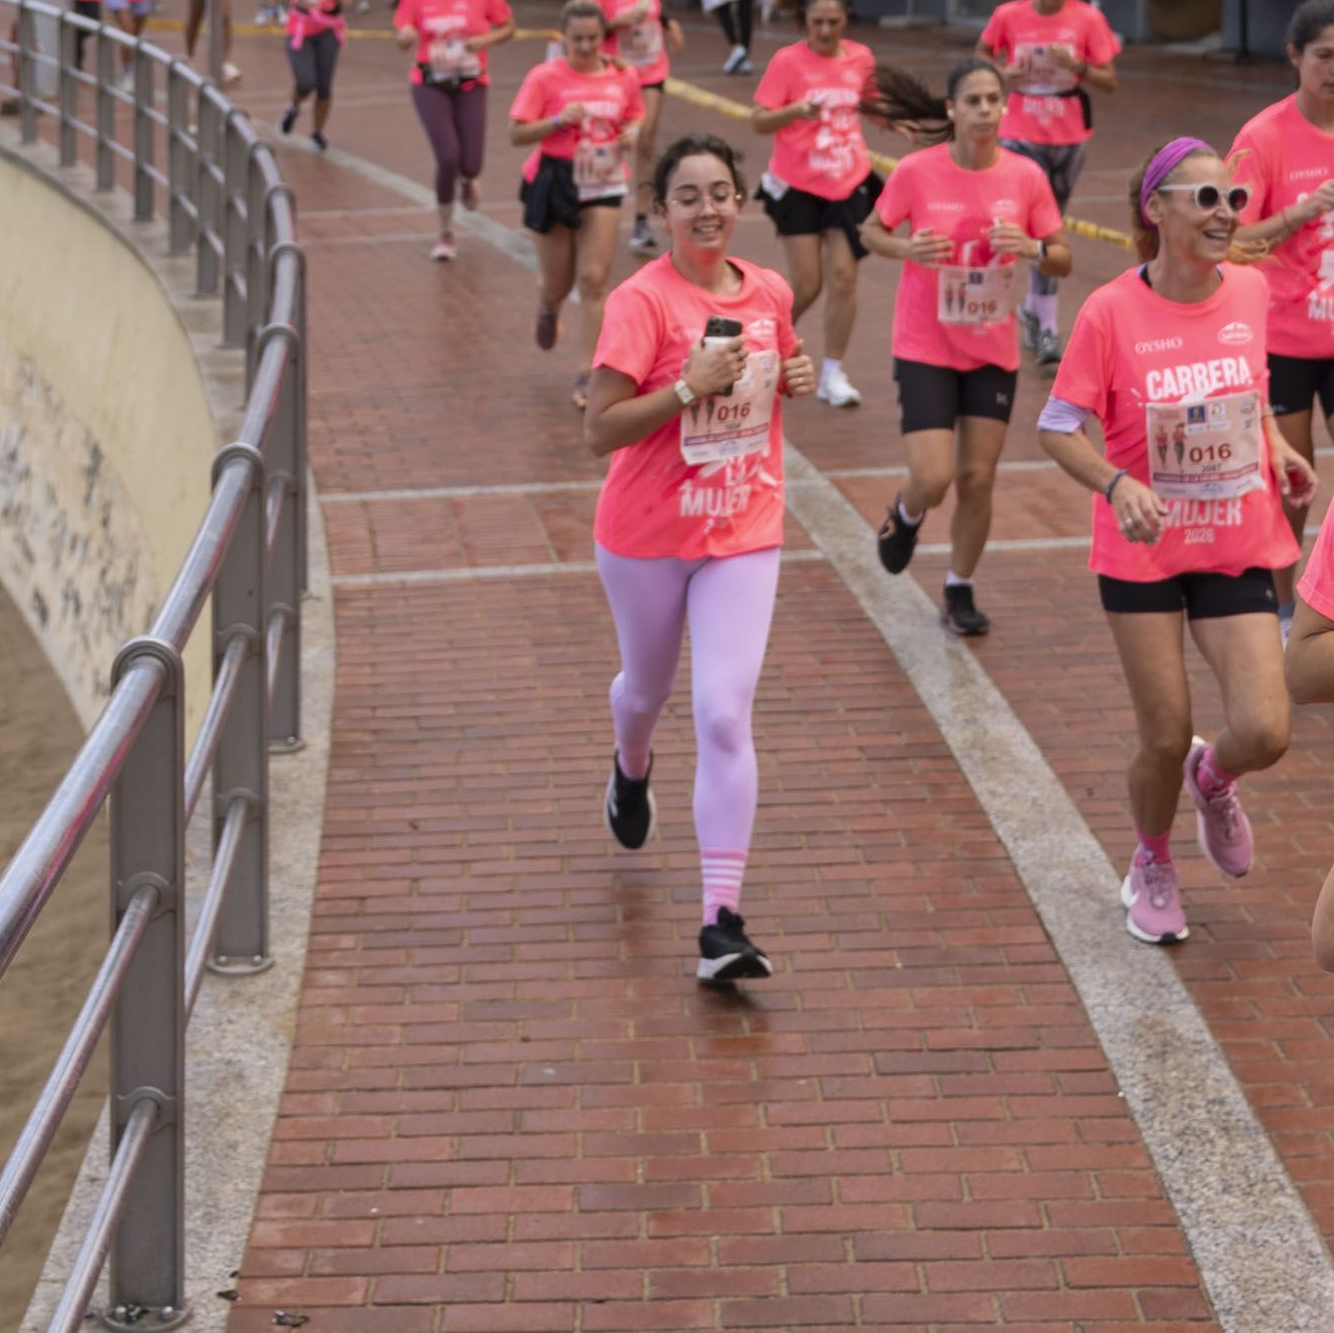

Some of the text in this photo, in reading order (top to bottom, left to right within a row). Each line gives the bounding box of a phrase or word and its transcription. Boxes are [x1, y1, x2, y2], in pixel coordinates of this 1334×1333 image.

[1135, 336, 1182, 354] OYSHO
[1146, 356, 1253, 400] CARRERA
[718, 402, 751, 421] 016
[1189, 443, 1231, 463] 016
